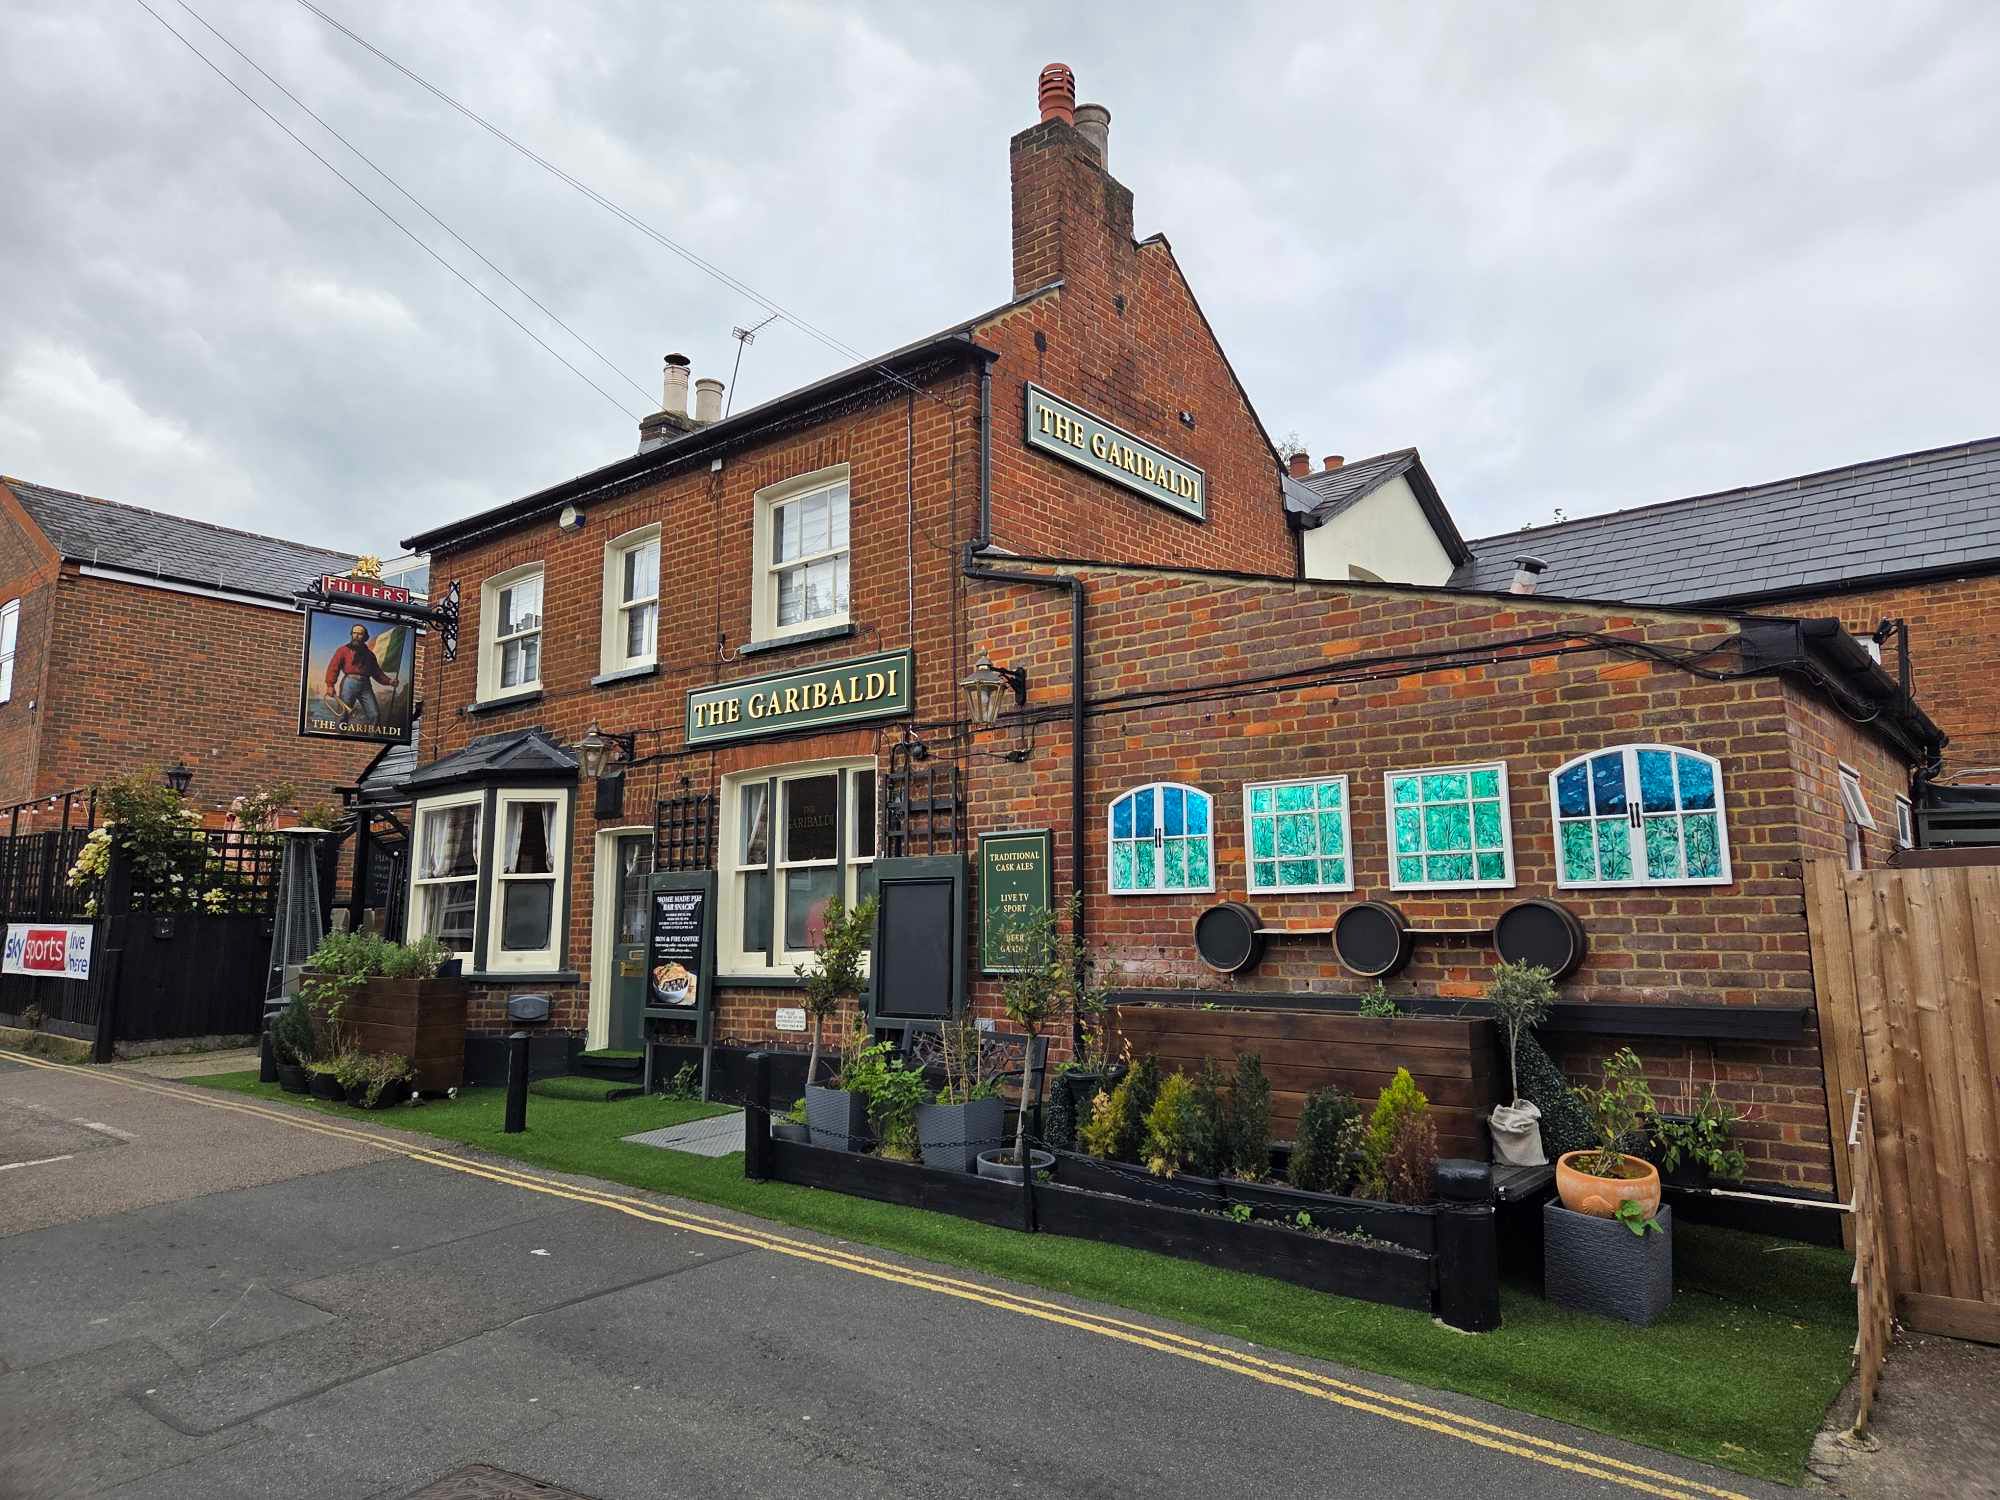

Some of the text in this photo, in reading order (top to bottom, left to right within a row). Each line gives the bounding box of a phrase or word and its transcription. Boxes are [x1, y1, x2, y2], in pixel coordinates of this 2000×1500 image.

[1038, 404, 1200, 503] THE GARIBALDI
[327, 576, 404, 603] FULLER'S
[693, 670, 897, 728] THE GARIBALDI
[312, 719, 401, 736] THE GARIBALDI
[990, 852, 1040, 862] TRADITIONAL
[996, 862, 1034, 872] CASK ALES
[1001, 893, 1029, 902] LIVE TV
[1003, 905, 1026, 913] SPORT
[6, 932, 63, 967] sky sports
[70, 930, 86, 950] live
[69, 953, 88, 973] here
